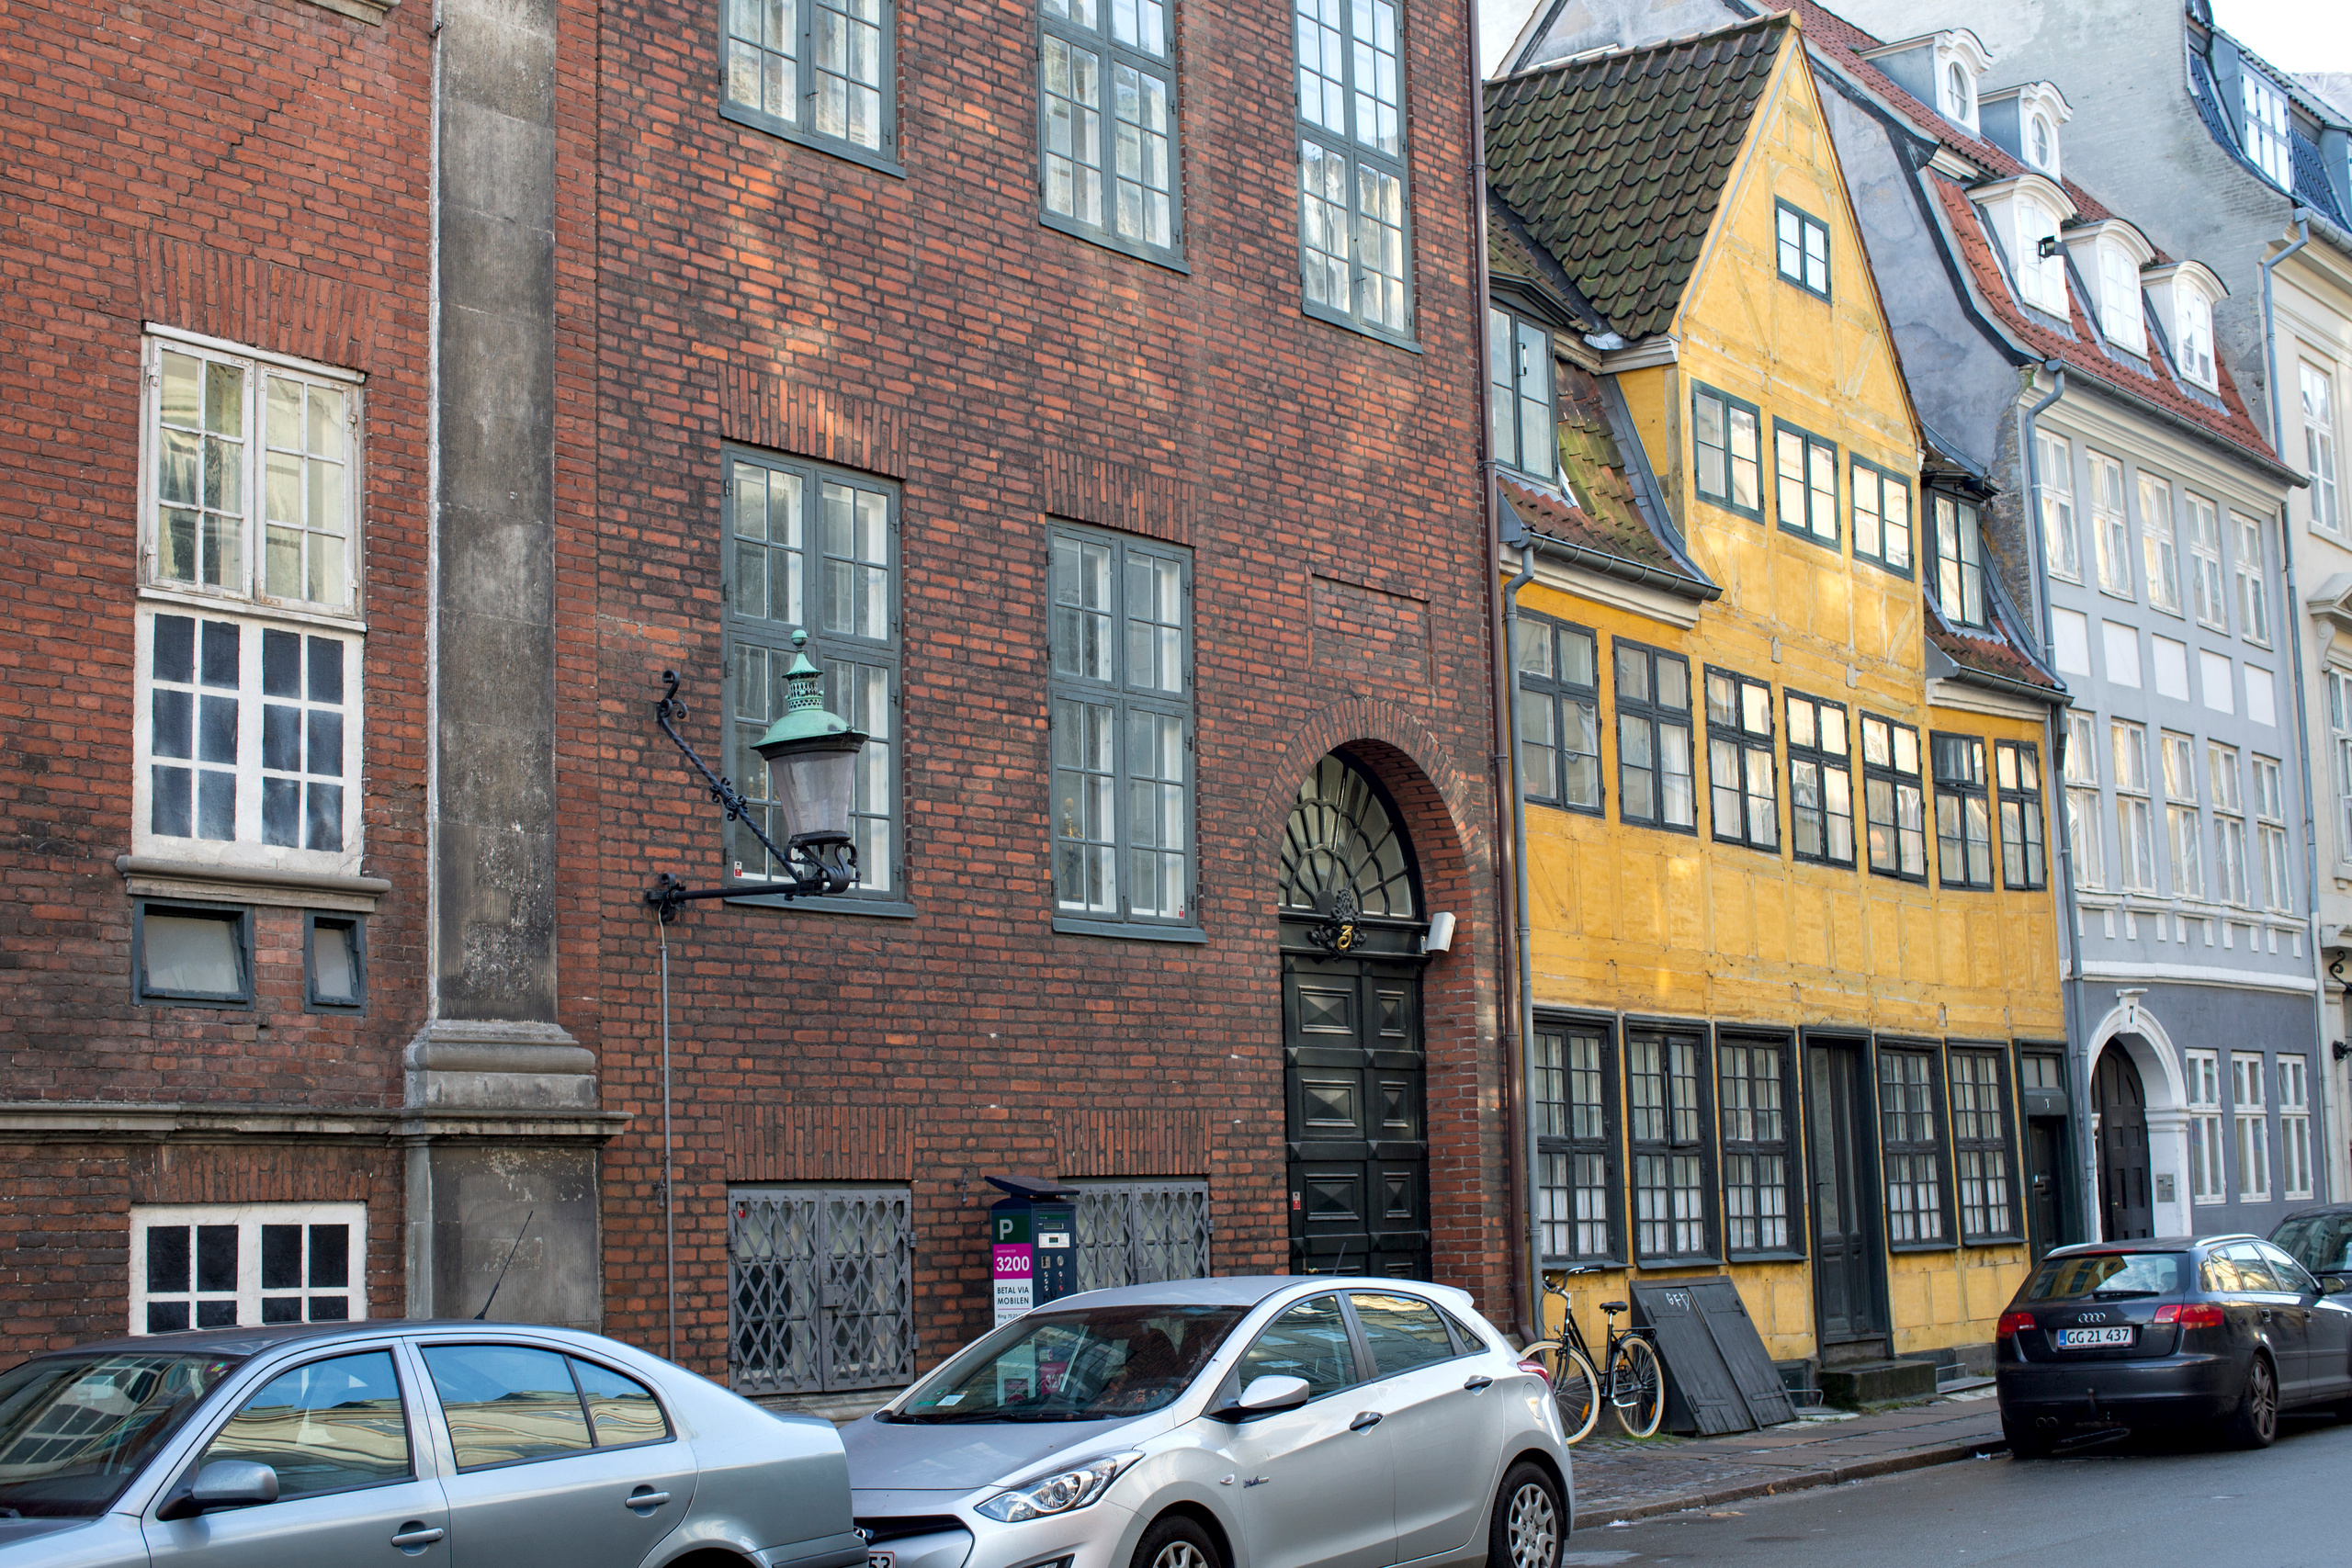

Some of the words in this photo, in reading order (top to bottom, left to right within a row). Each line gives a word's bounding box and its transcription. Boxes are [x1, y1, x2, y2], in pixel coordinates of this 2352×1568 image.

[1337, 925, 1352, 950] 3
[2129, 1006, 2134, 1023] 7
[999, 1219, 1013, 1240] P
[996, 1256, 1030, 1272] 3200
[2067, 1332, 2084, 1343] GG
[2087, 1330, 2101, 1342] 21
[2106, 1329, 2129, 1341] 437
